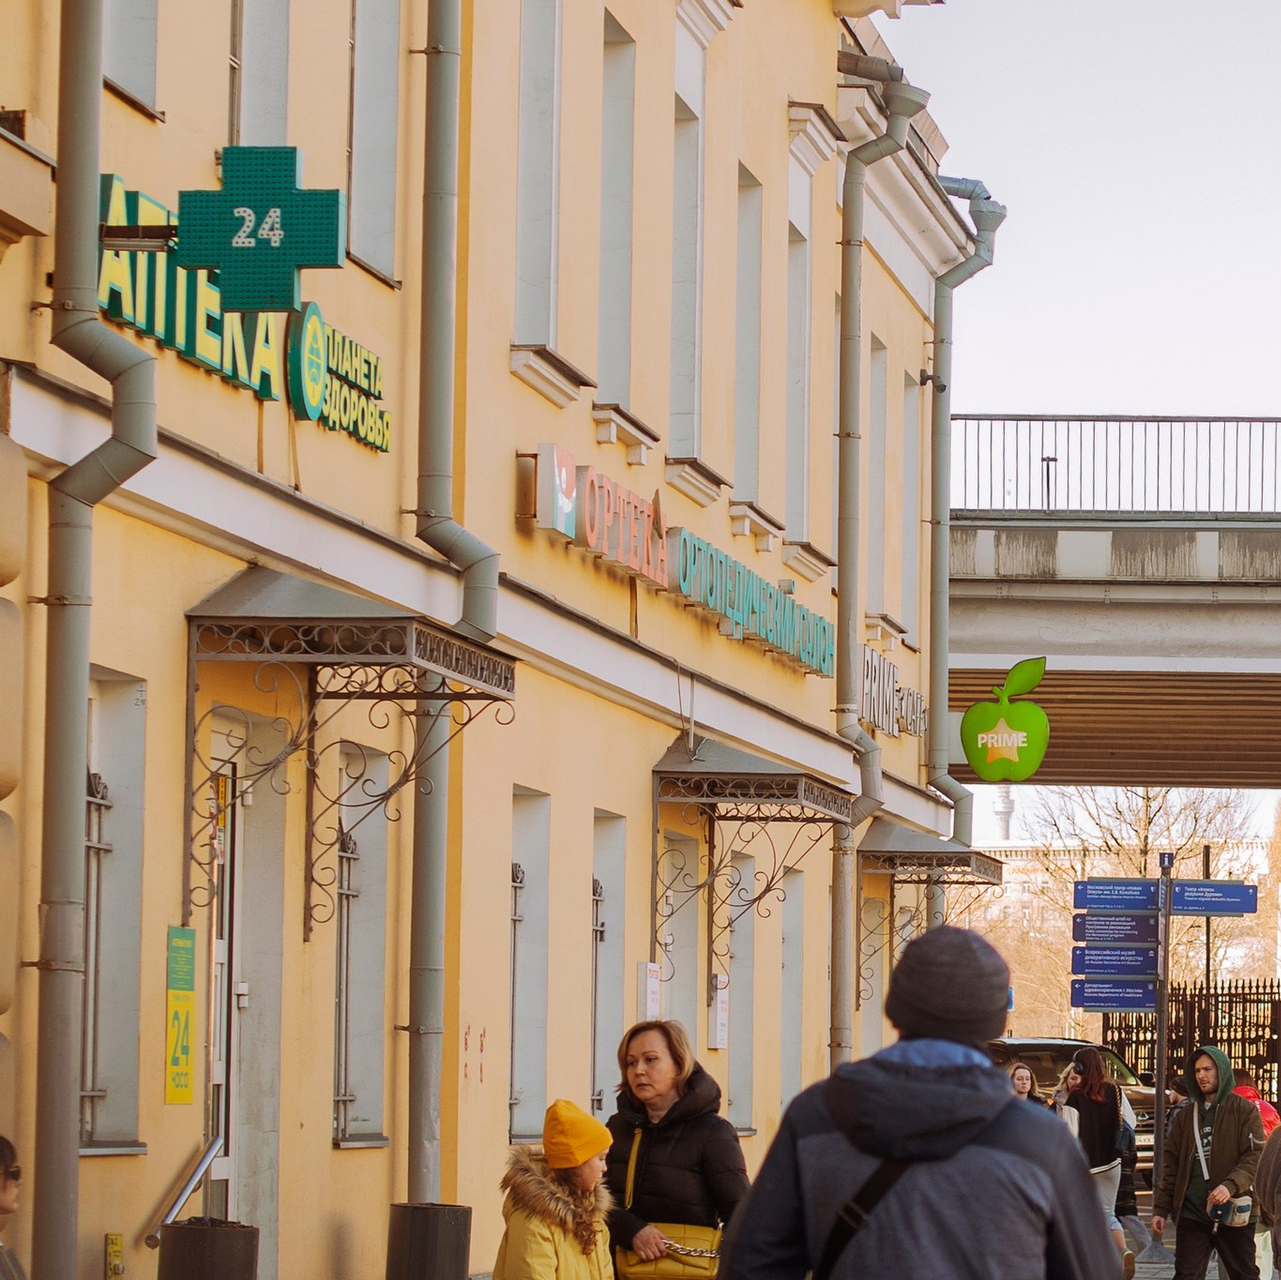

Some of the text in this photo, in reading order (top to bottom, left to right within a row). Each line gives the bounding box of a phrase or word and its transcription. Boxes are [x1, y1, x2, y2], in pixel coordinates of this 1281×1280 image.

[231, 207, 284, 247] 24
[324, 323, 384, 400] ПЛАНЕТА
[323, 374, 392, 452] ЗДОРОВЬЯ
[679, 527, 835, 678] ОРТОПЕДИЧЕСКИЙ САЛОН
[977, 732, 1028, 748] PRIME
[171, 1010, 189, 1067] 24
